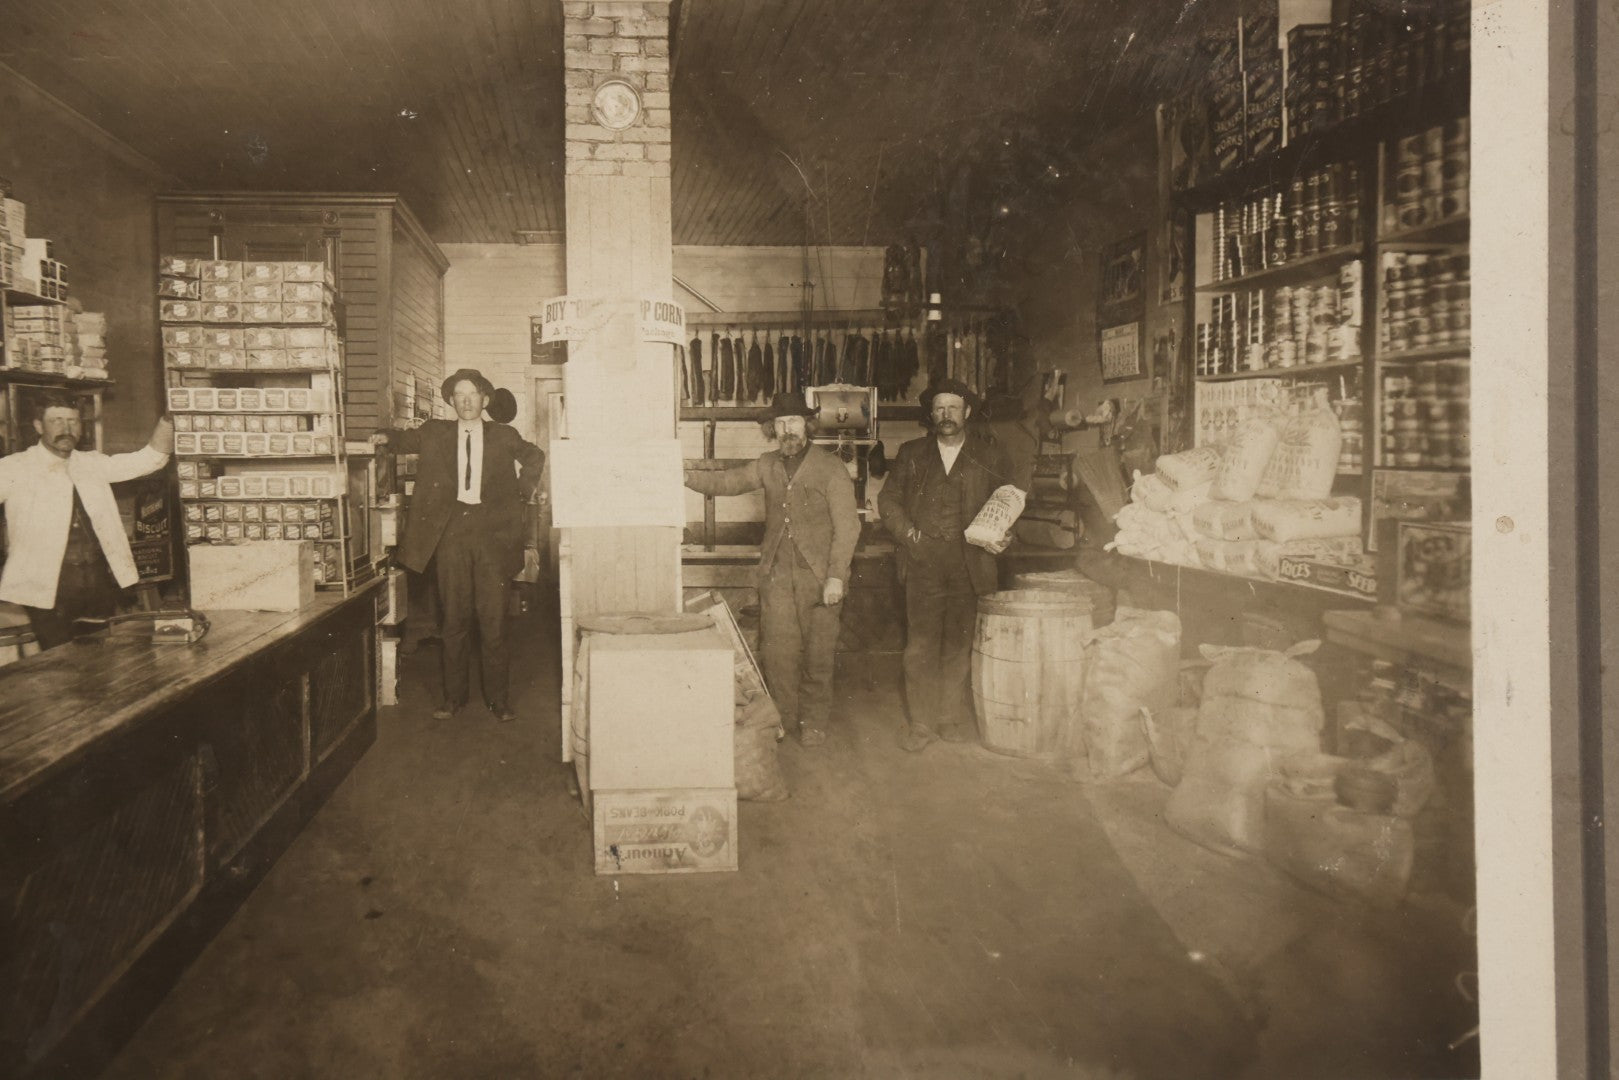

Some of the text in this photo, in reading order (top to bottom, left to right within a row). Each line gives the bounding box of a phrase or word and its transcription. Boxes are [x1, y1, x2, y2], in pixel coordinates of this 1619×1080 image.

[545, 300, 567, 324] BUY
[655, 302, 683, 327] CORN
[136, 518, 168, 534] BISCUIT
[610, 807, 647, 819] BEANS
